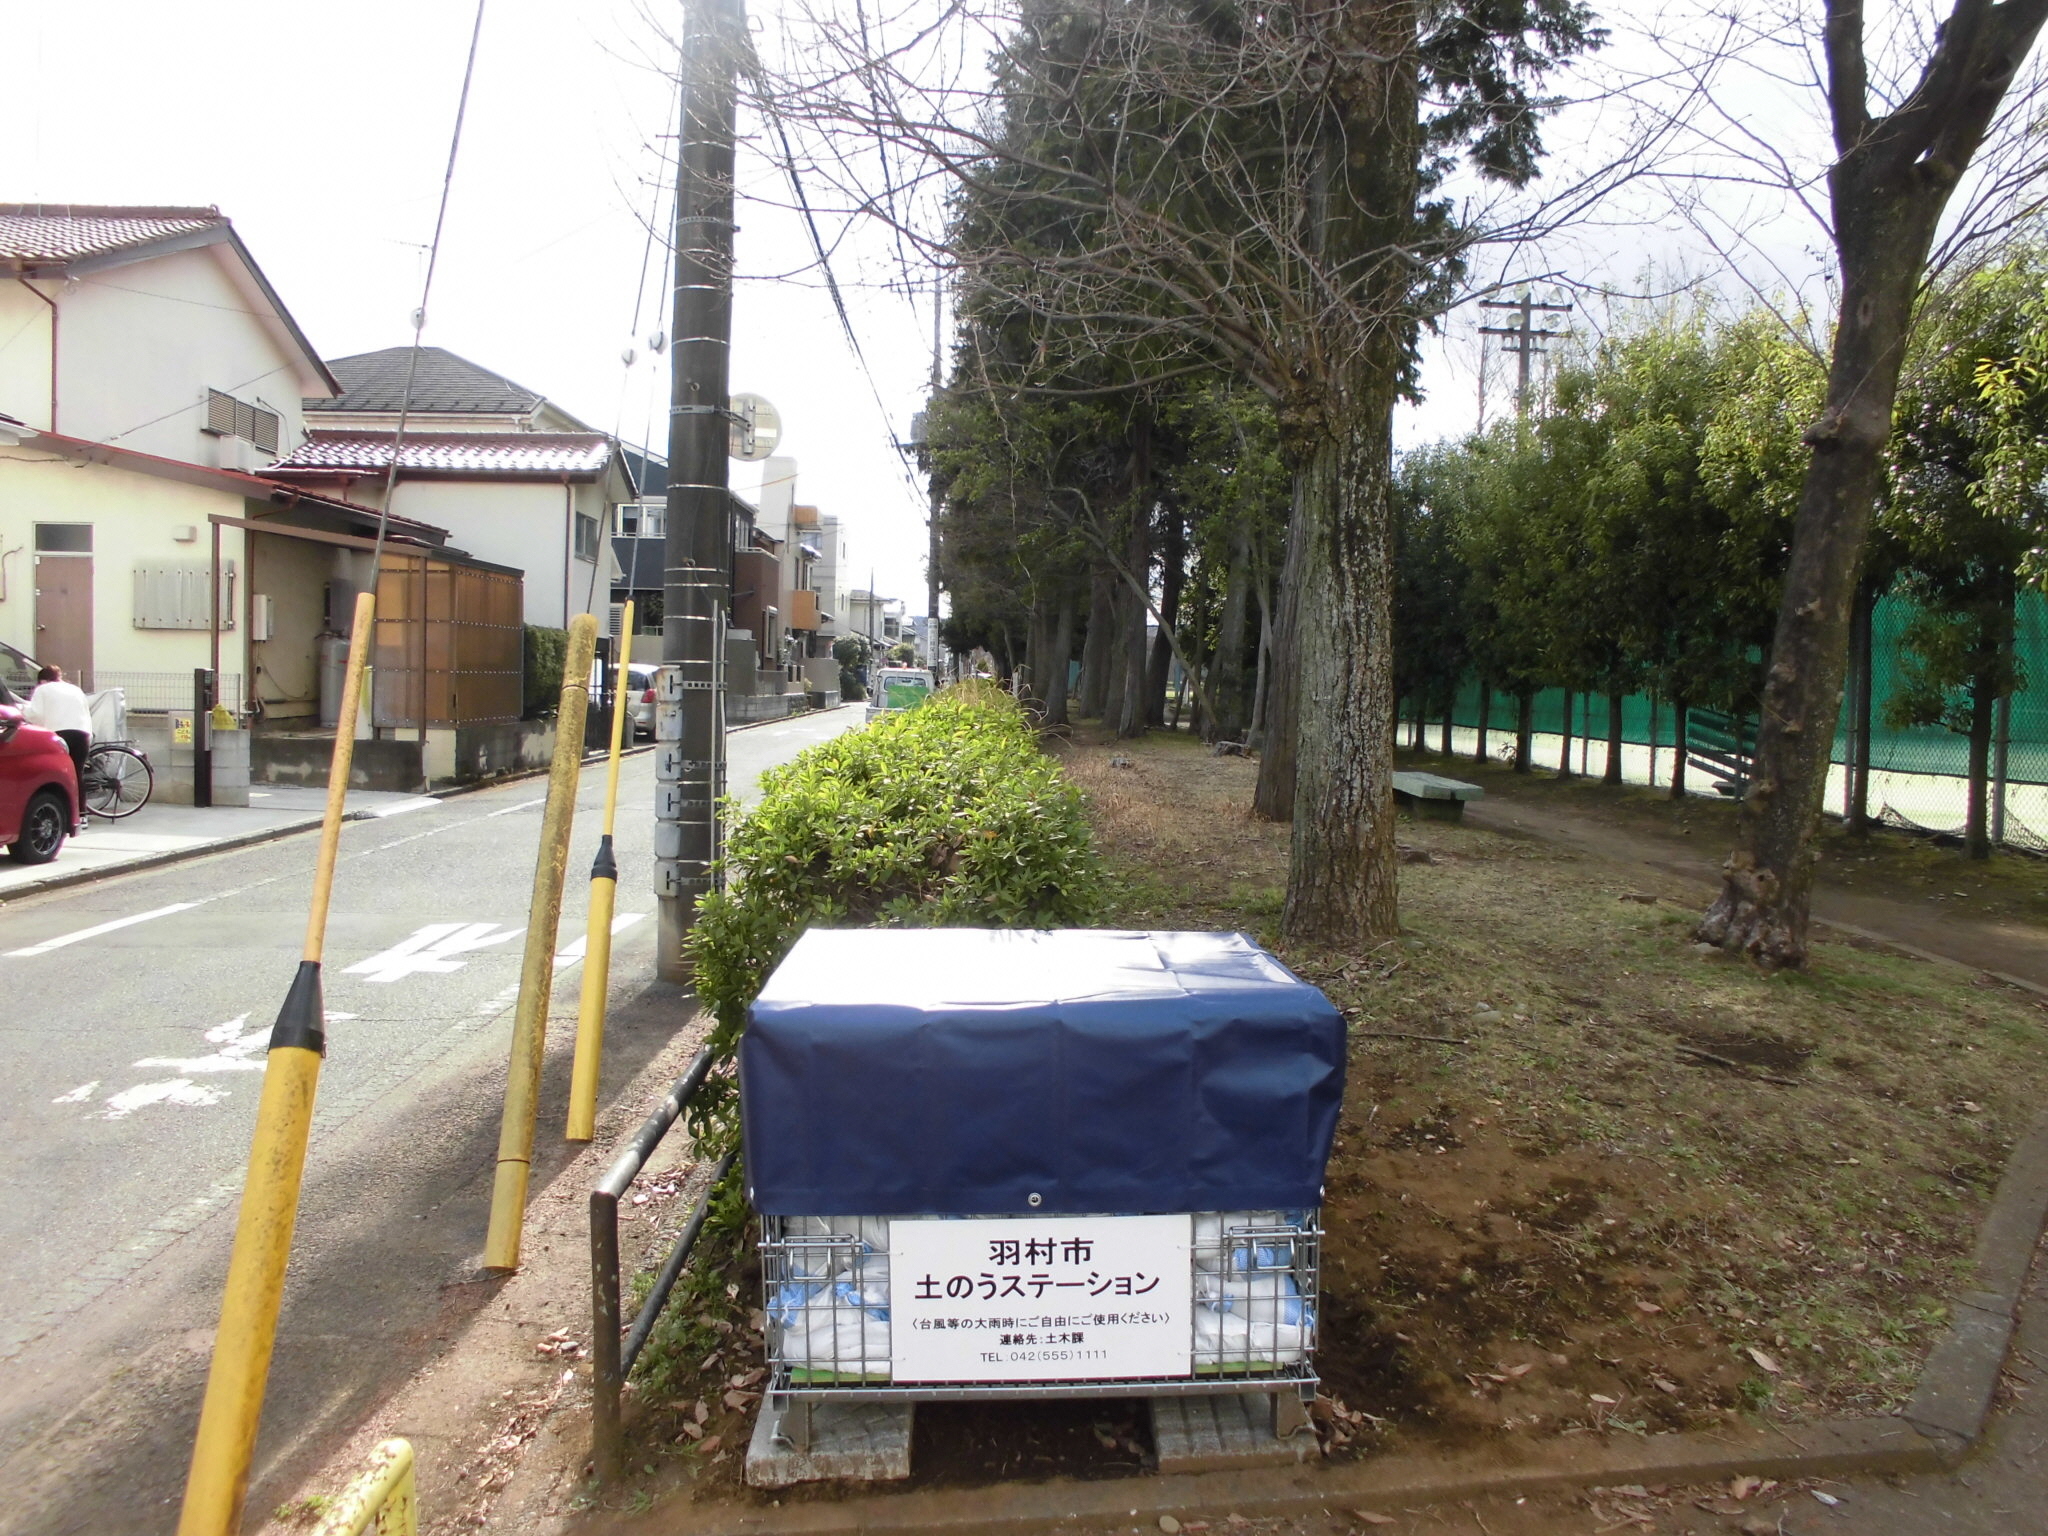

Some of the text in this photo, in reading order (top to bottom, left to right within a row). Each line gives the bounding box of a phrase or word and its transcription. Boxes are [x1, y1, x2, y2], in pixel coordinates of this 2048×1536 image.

[989, 1236, 1094, 1266] 羽村市
[914, 1271, 1160, 1300] 土のうステーション
